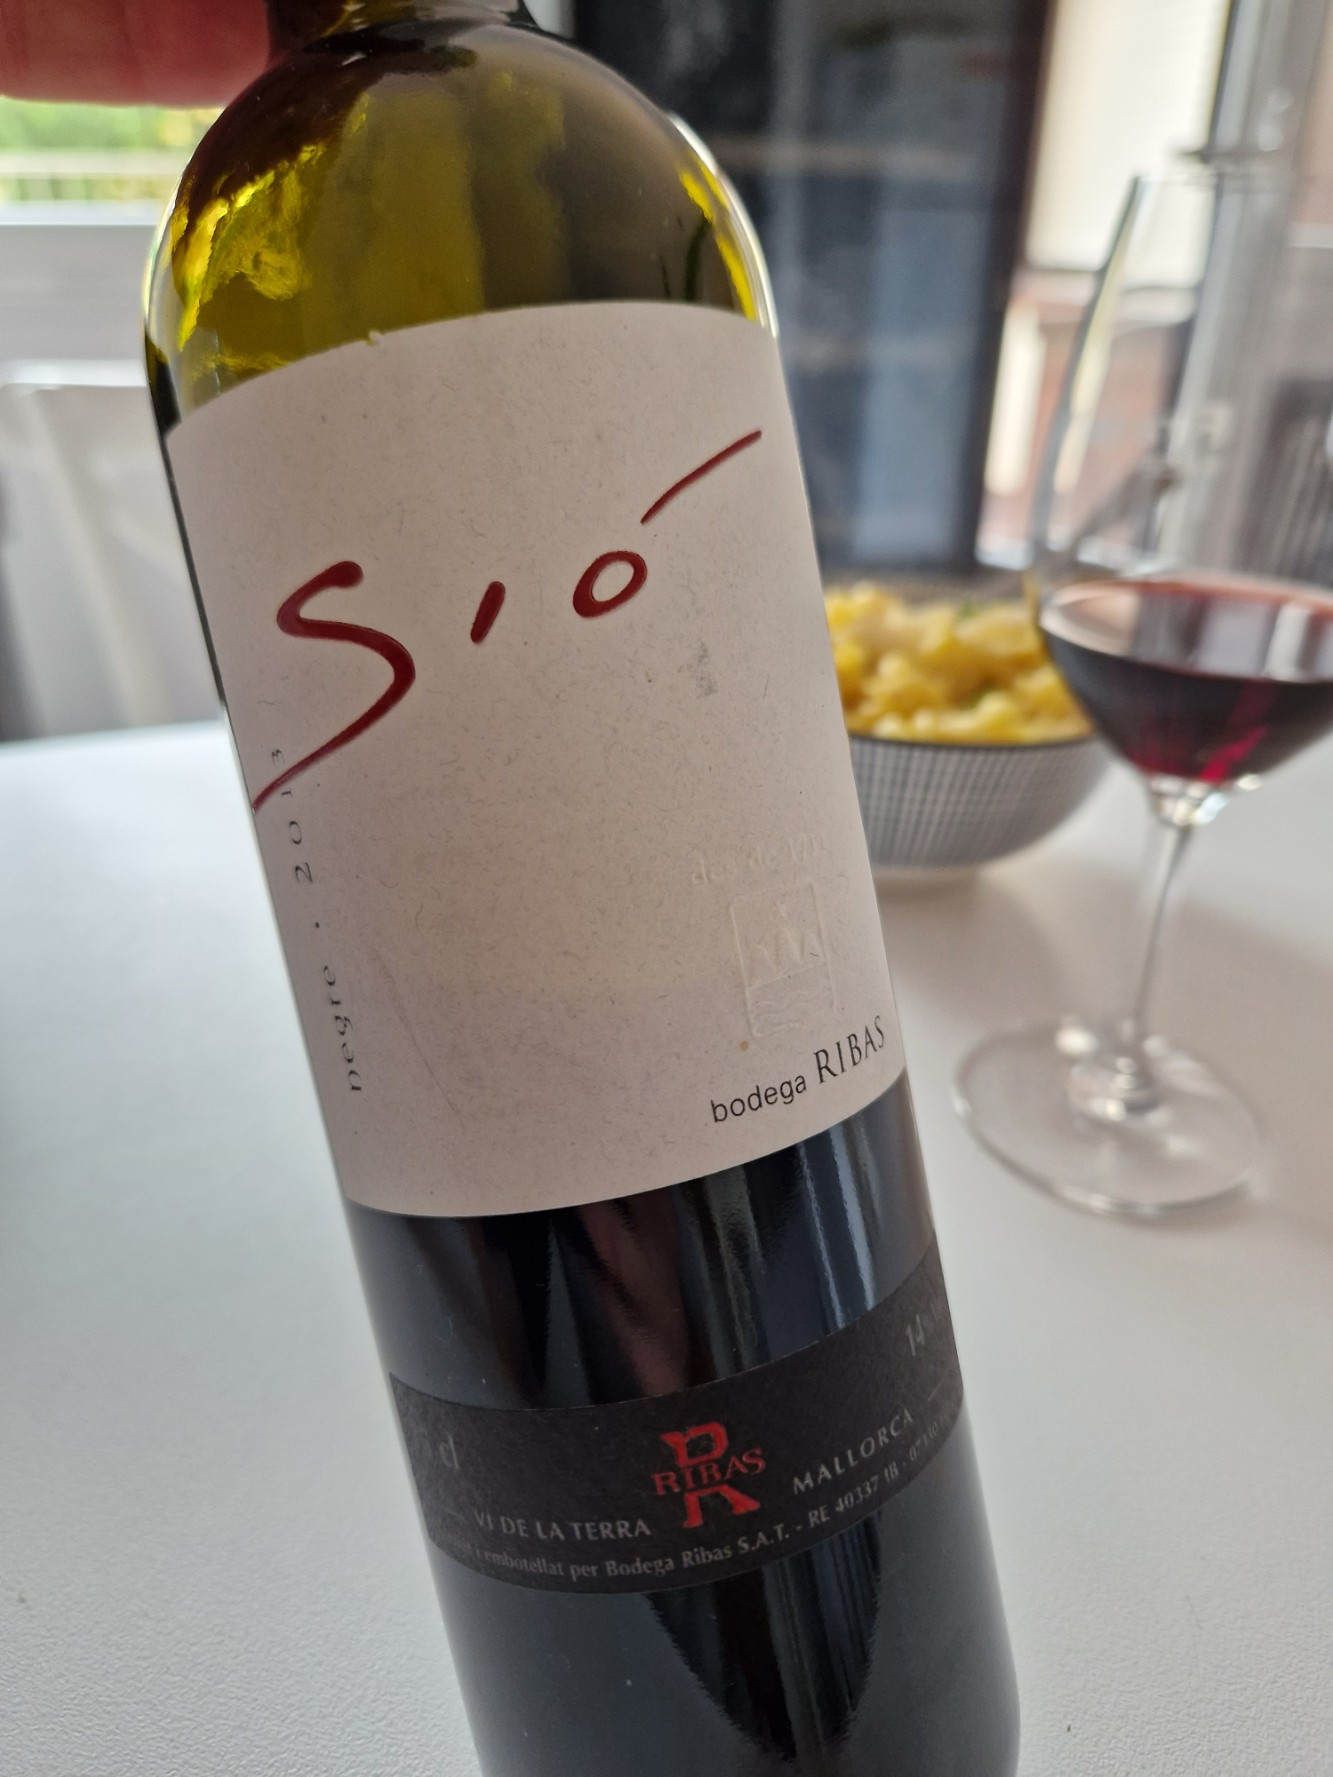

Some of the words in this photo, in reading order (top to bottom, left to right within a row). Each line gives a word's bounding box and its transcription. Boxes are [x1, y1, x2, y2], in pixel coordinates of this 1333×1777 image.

[270, 748, 314, 885] 2013
[322, 964, 363, 1093] negre
[710, 1074, 808, 1124] bodega
[813, 1015, 886, 1084] RIBAS
[650, 1447, 767, 1496] RIBAS
[792, 1407, 915, 1495] MALLORCA
[473, 1508, 494, 1531] VI
[500, 1514, 529, 1538] DE
[535, 1521, 566, 1541] LA
[570, 1517, 651, 1541] TERRA
[568, 1563, 599, 1583] per
[605, 1557, 675, 1578] Bodega
[681, 1544, 733, 1569] Ribas
[736, 1522, 790, 1556] S.A.T.
[807, 1503, 831, 1529] RE
[834, 1473, 880, 1513] 40337
